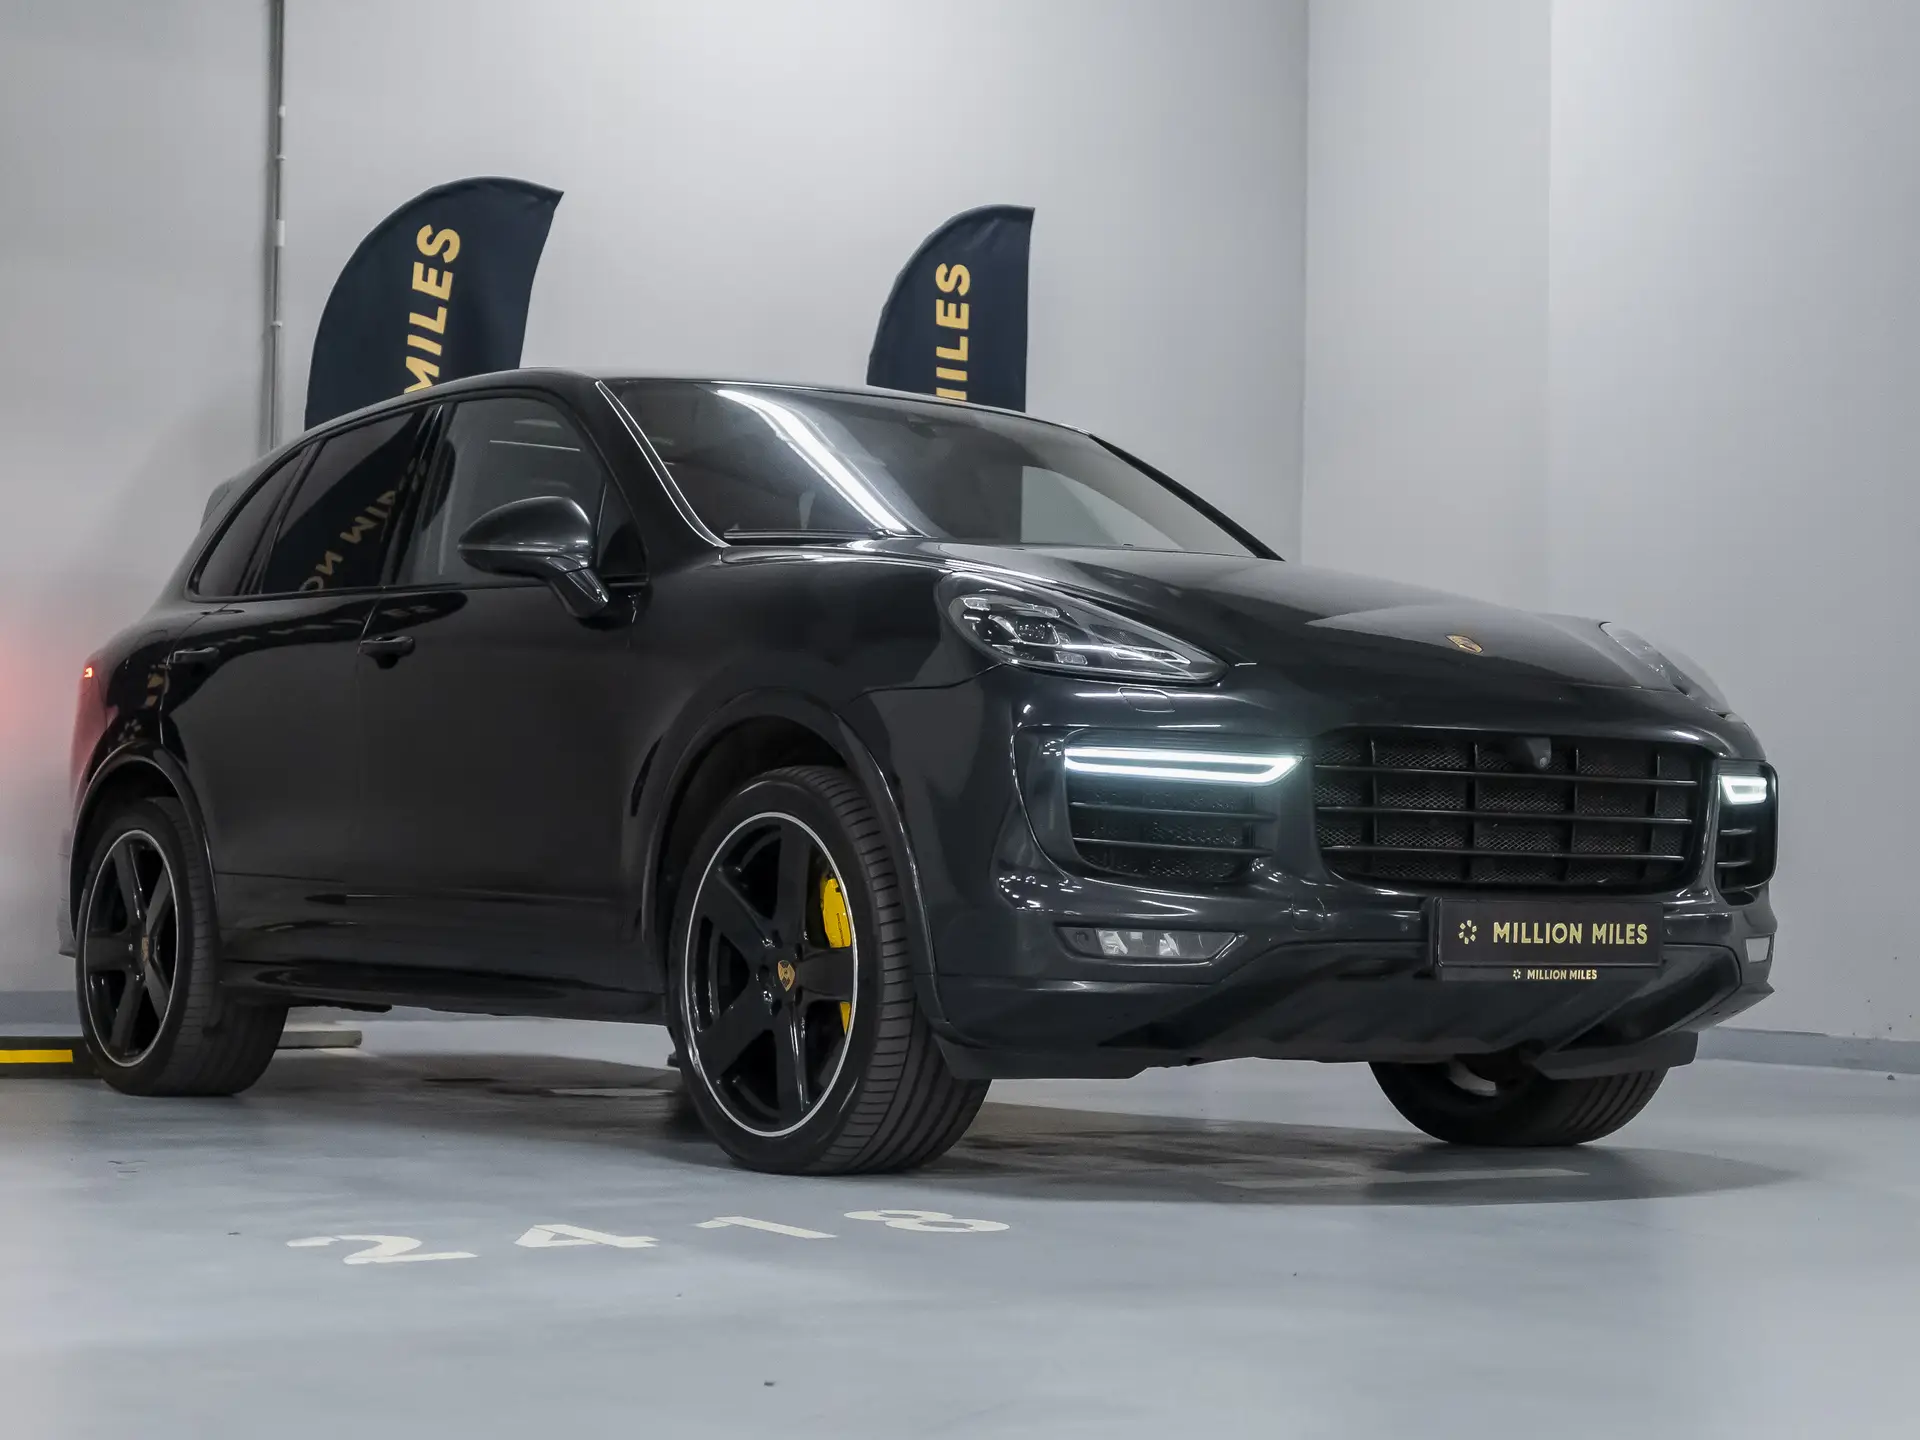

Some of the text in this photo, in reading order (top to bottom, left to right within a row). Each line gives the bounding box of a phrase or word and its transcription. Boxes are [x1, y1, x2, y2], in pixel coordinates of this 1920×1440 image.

[403, 223, 461, 394] MILES
[935, 262, 971, 402] ILES
[1493, 921, 1648, 945] MILLION MILES
[1526, 969, 1598, 980] MILLION MILES
[286, 1209, 1010, 1265] 2418
